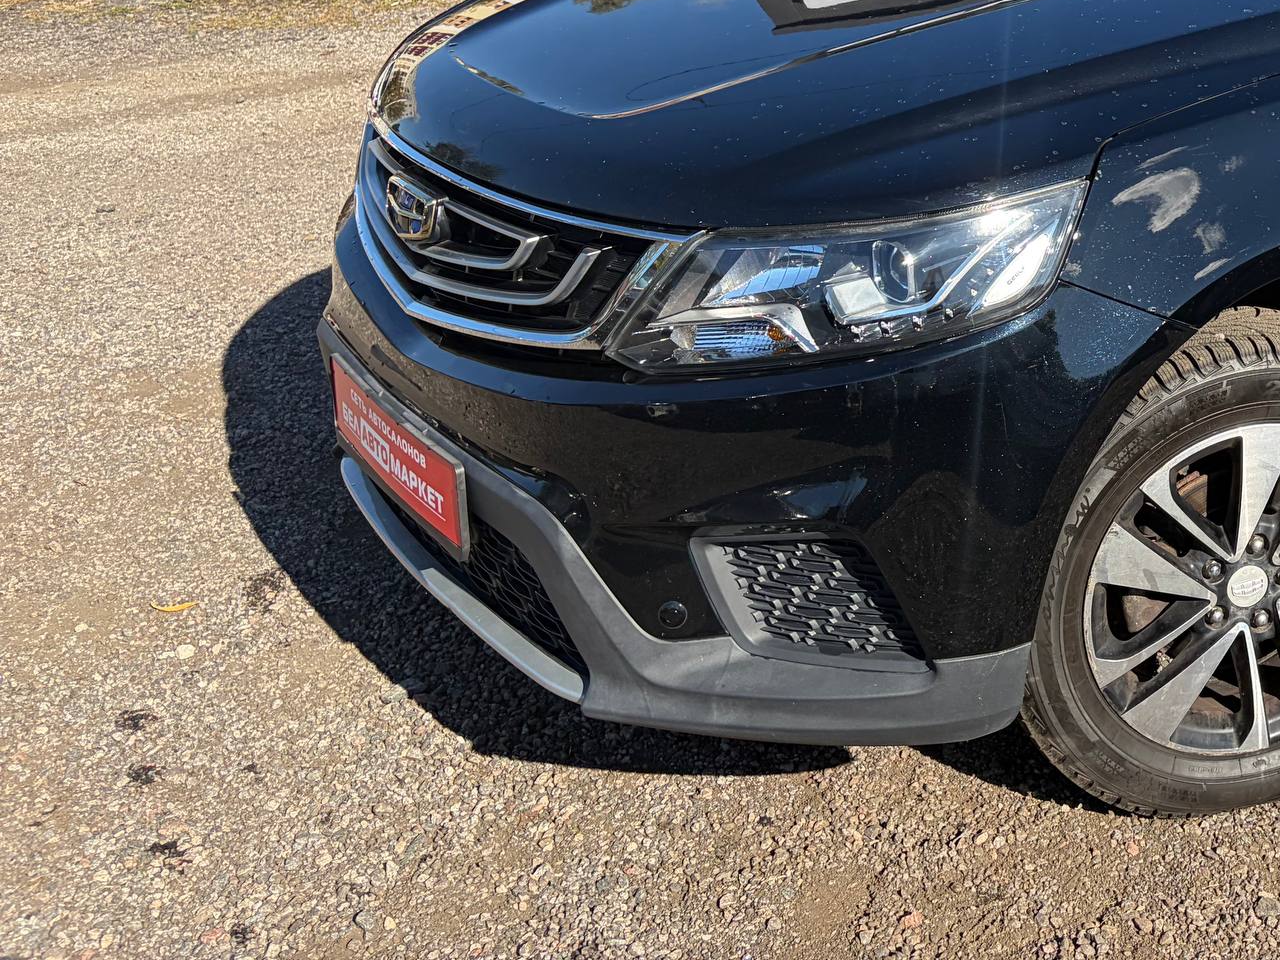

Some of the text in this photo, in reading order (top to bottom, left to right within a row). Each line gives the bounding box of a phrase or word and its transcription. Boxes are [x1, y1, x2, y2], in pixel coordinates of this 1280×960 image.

[342, 401, 444, 514] БЕЛ АВТО МАРКЕТ
[350, 388, 427, 469] СЕТЬ АВТОСАЛОНОВ
